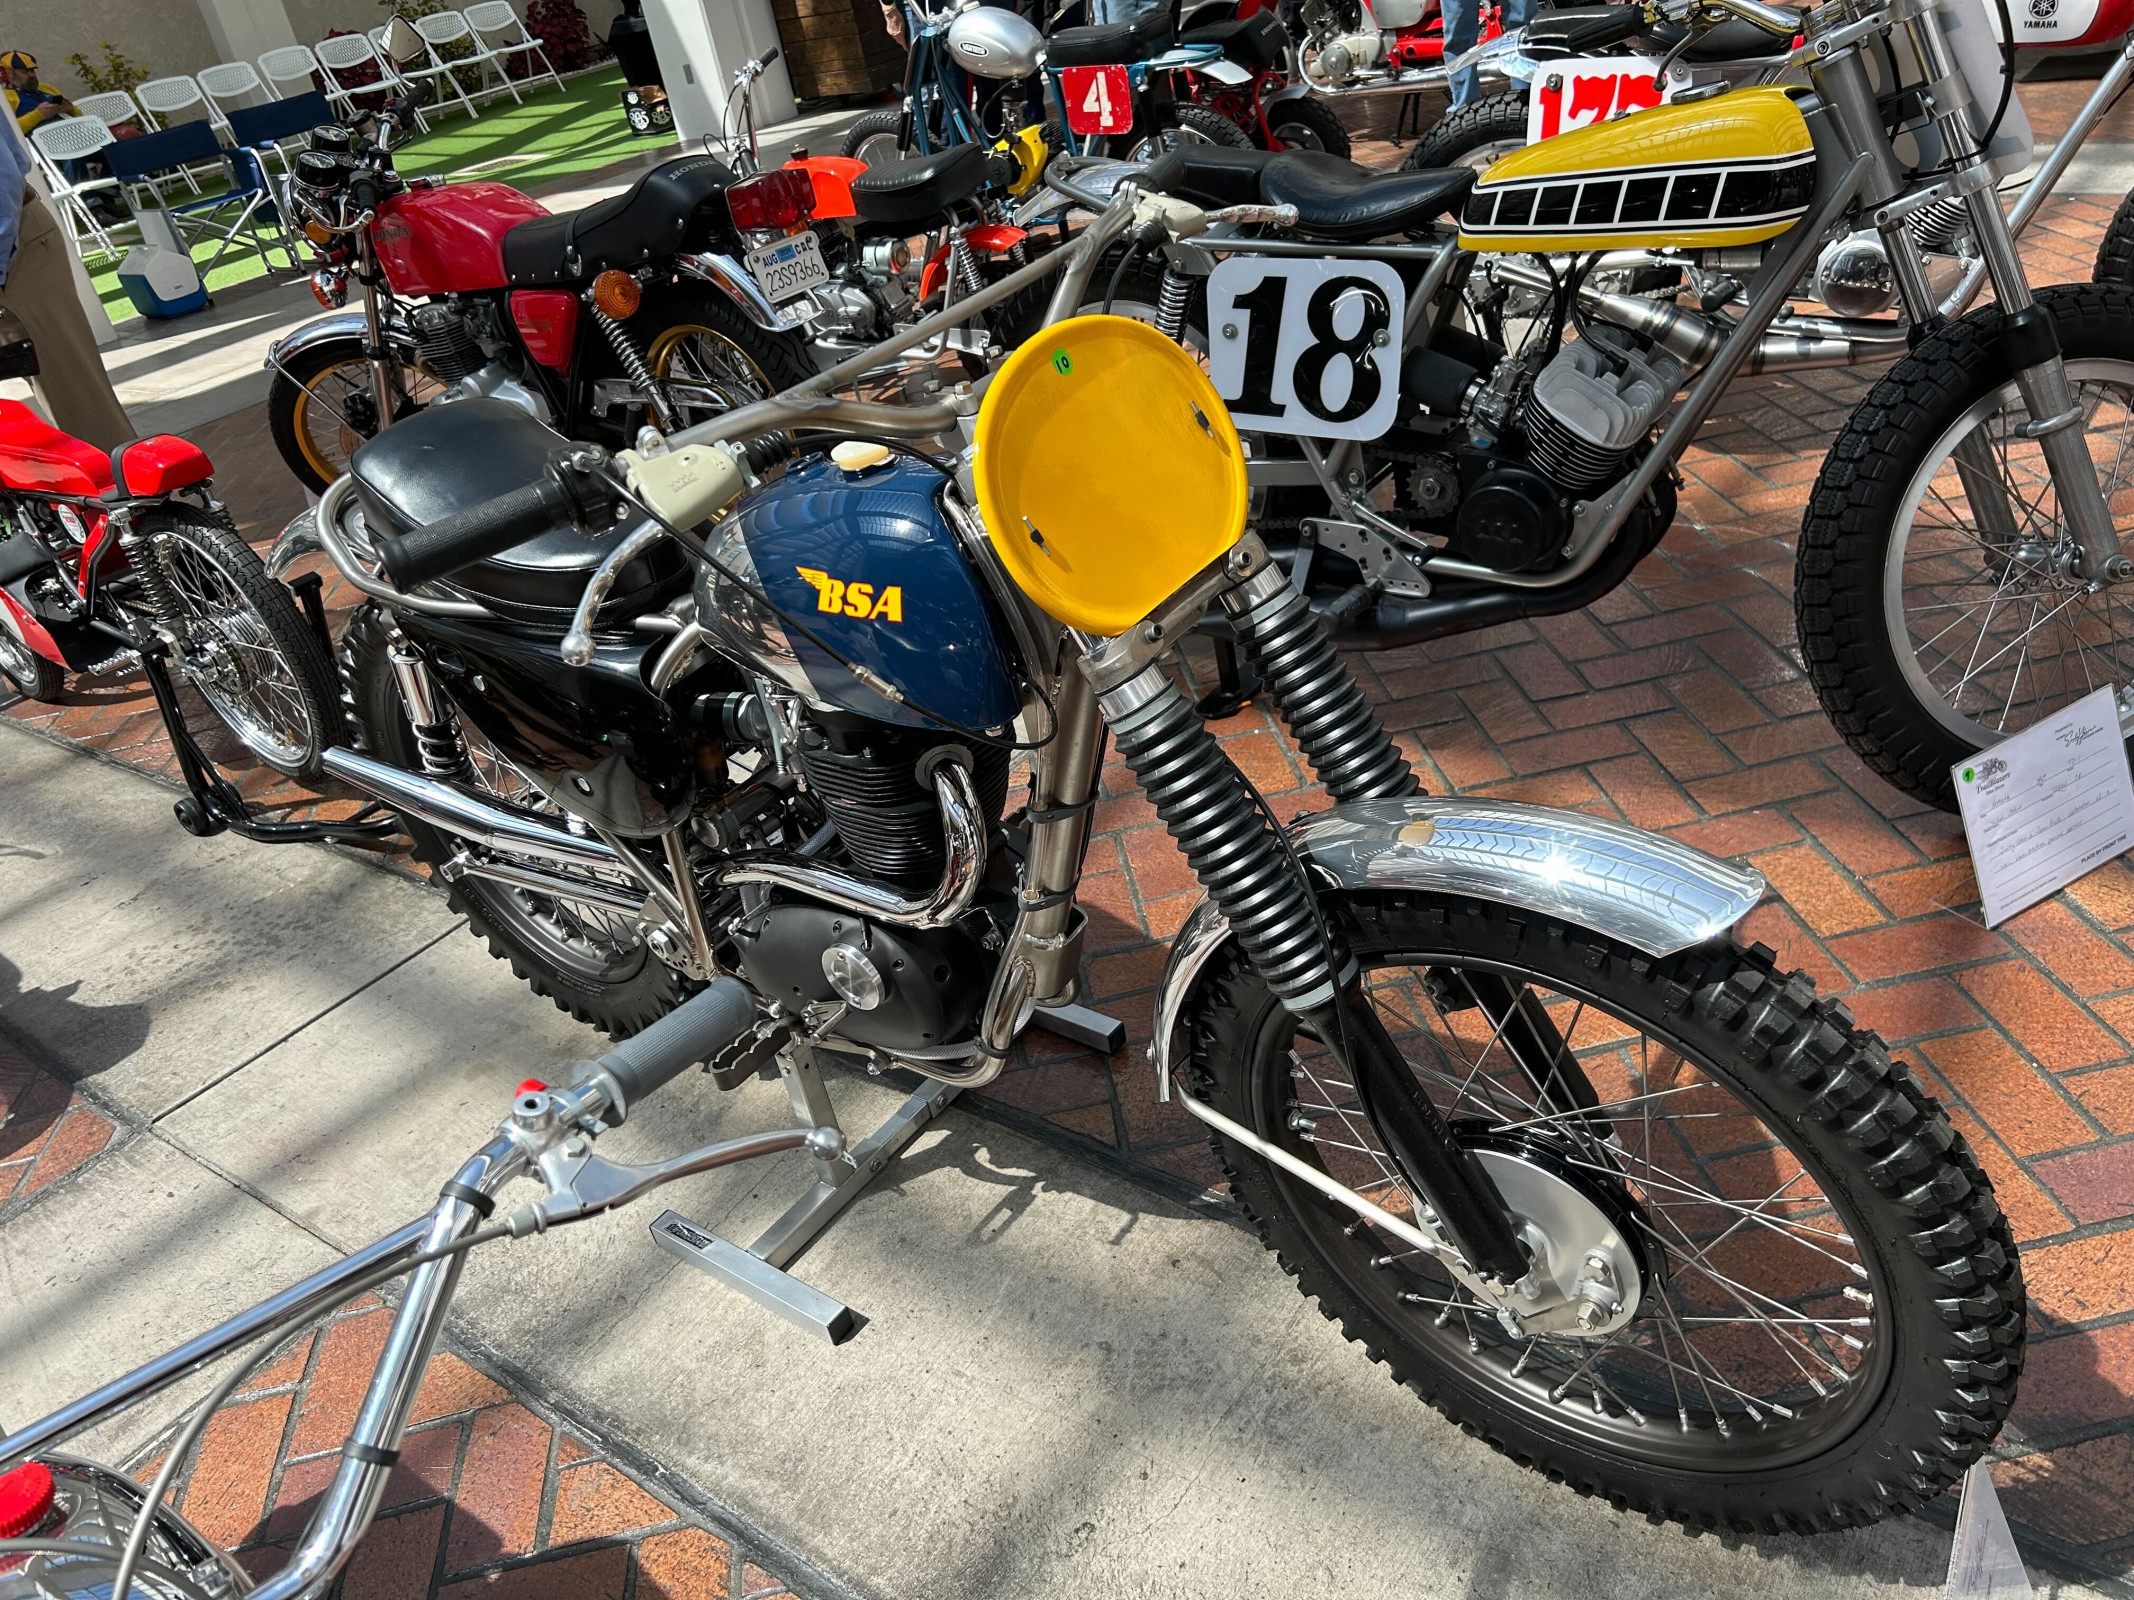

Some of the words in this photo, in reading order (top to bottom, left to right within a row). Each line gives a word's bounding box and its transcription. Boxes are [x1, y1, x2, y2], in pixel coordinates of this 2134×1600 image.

[2023, 20, 2058, 29] YAMAHA
[1082, 71, 1114, 127] 4
[668, 161, 719, 181] HONDA
[373, 226, 409, 240] HONDA
[762, 254, 779, 268] AUG
[795, 237, 814, 254] CAL
[765, 256, 820, 293] 23S9366
[1055, 355, 1070, 374] 10
[1223, 276, 1391, 423] 18
[817, 578, 903, 623] BSA
[2081, 852, 2096, 863] PLACE
[2102, 840, 2117, 852] FRONT
[2116, 833, 2127, 843] TIRE
